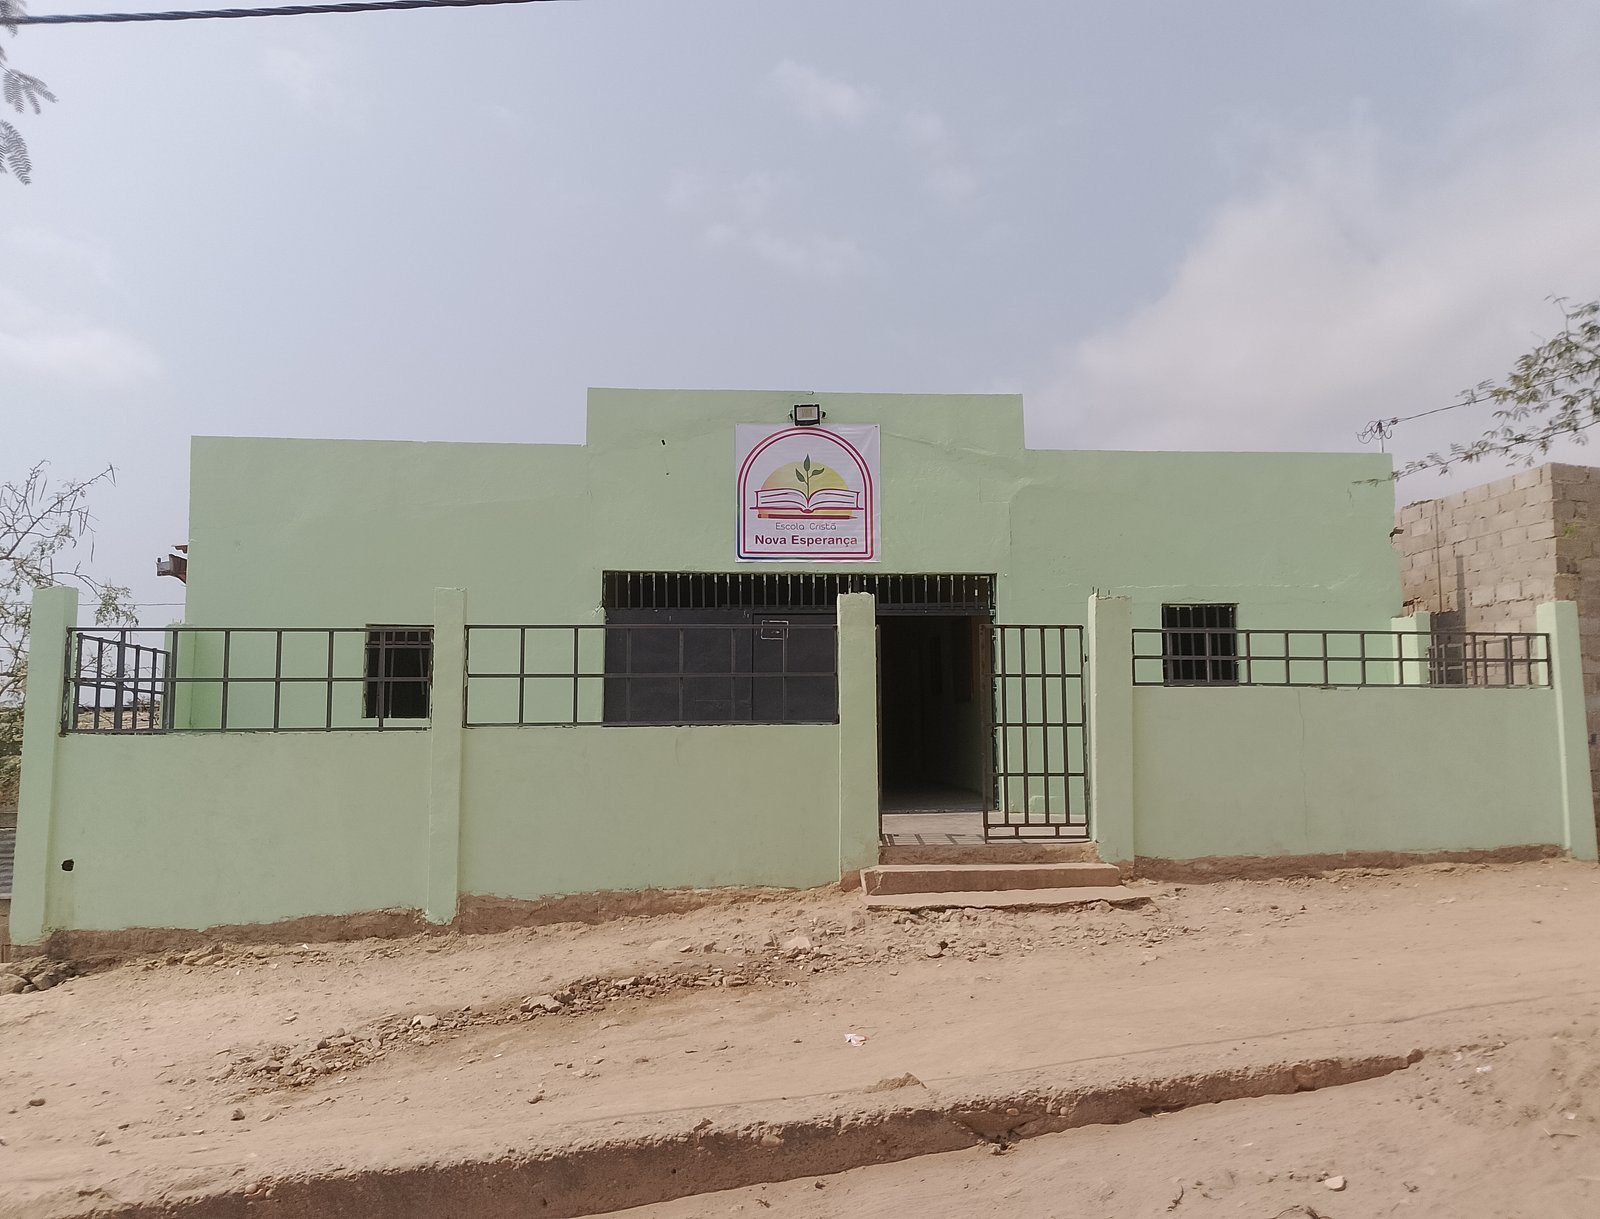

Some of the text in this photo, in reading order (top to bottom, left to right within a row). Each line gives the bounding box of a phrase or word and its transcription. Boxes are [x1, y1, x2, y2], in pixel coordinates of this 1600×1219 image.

[775, 522, 837, 531] Escola Cristã
[755, 534, 858, 547] Nova Esperança
